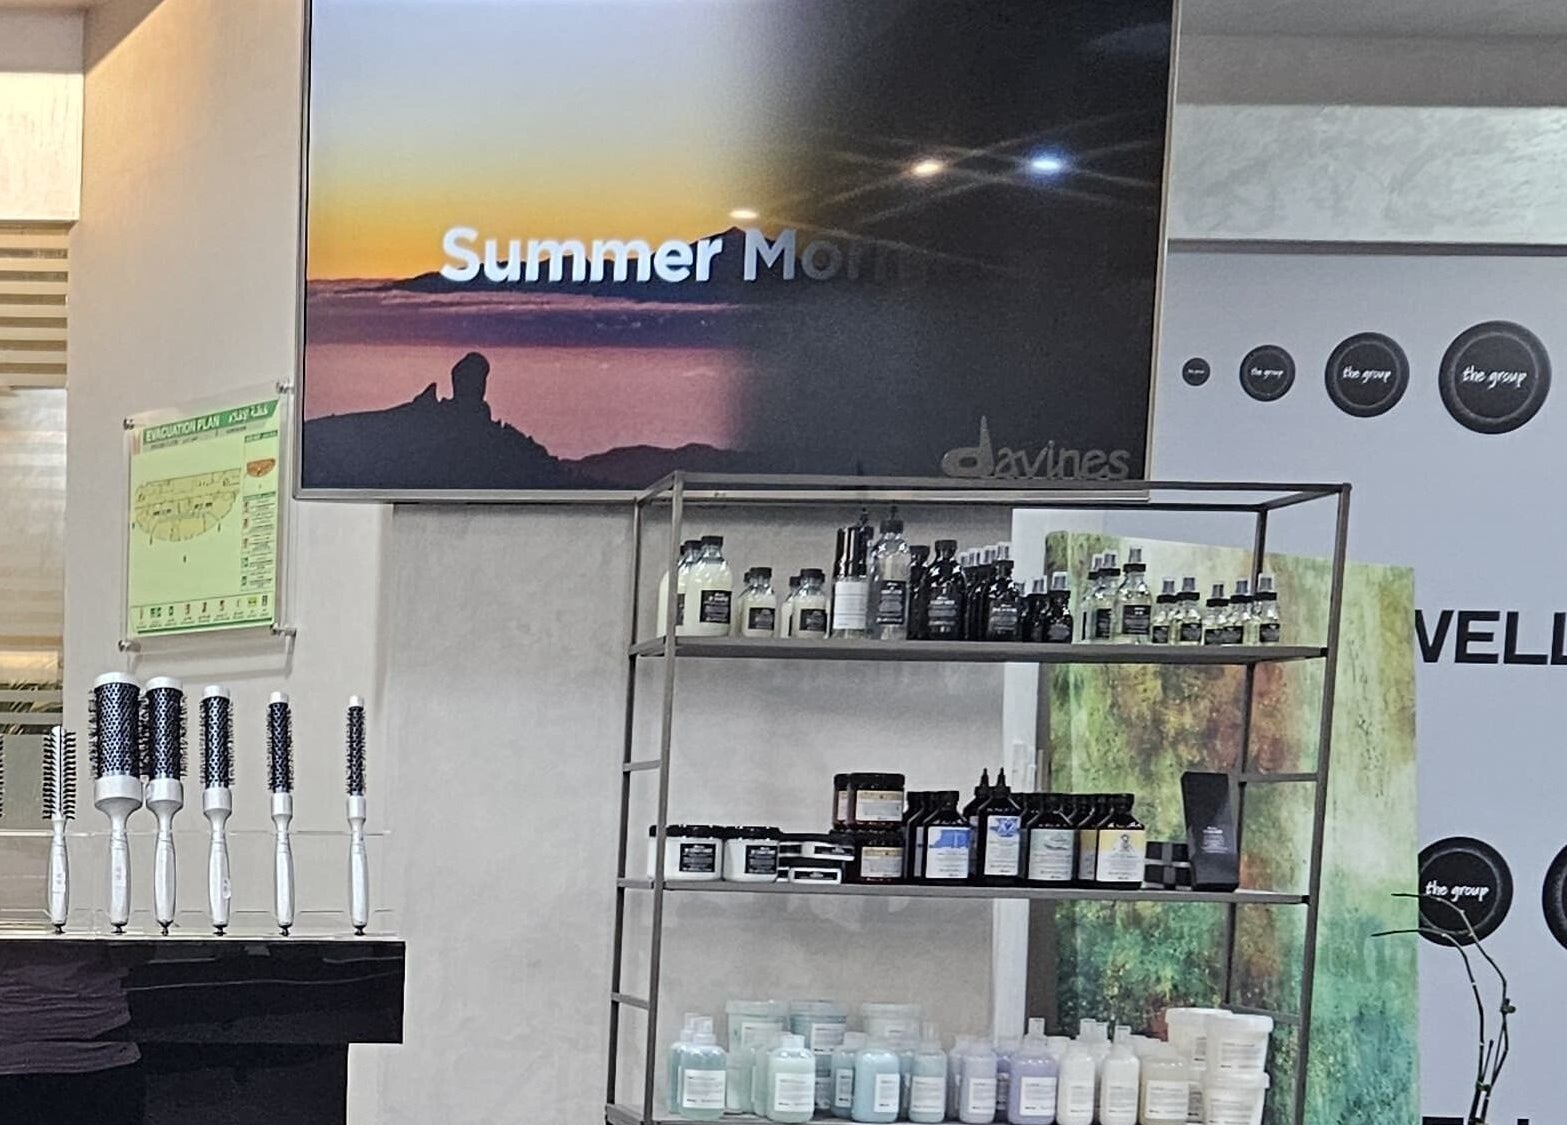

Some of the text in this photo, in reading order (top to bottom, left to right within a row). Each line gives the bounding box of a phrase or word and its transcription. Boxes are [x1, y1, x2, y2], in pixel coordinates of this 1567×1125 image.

[440, 226, 724, 283] Summer
[1342, 365, 1392, 384] the group
[1462, 364, 1527, 391] the group
[145, 419, 196, 443] EVACUATION
[196, 415, 220, 431] PLAN
[941, 415, 1130, 480] davines
[1425, 880, 1490, 902] the group
